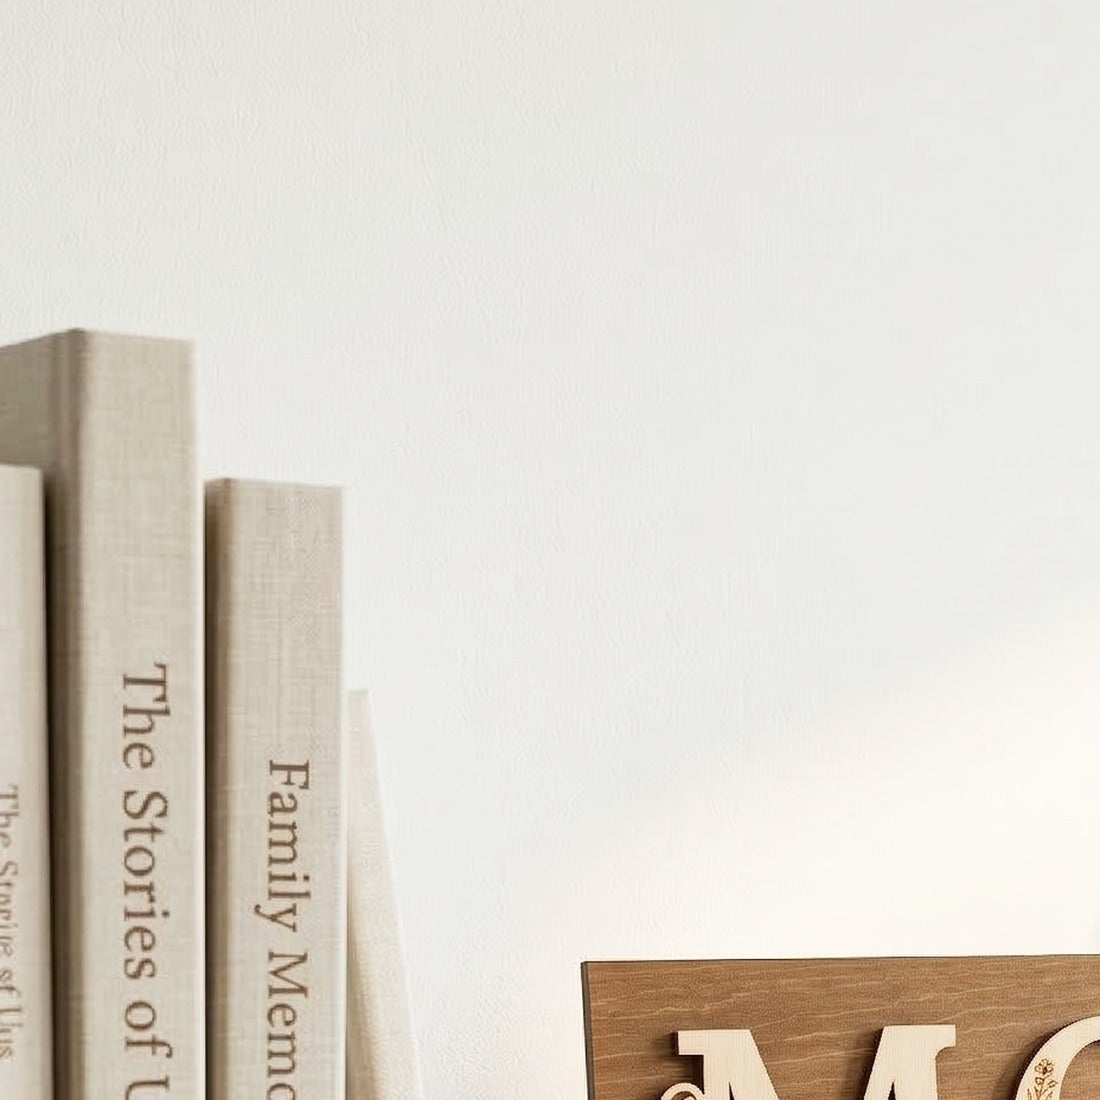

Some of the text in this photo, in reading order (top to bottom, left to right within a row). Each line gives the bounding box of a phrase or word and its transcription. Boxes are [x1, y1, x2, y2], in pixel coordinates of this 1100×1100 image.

[122, 661, 171, 769] The
[122, 789, 170, 981] Stories
[254, 759, 311, 933] Family
[123, 1000, 173, 1060] of
